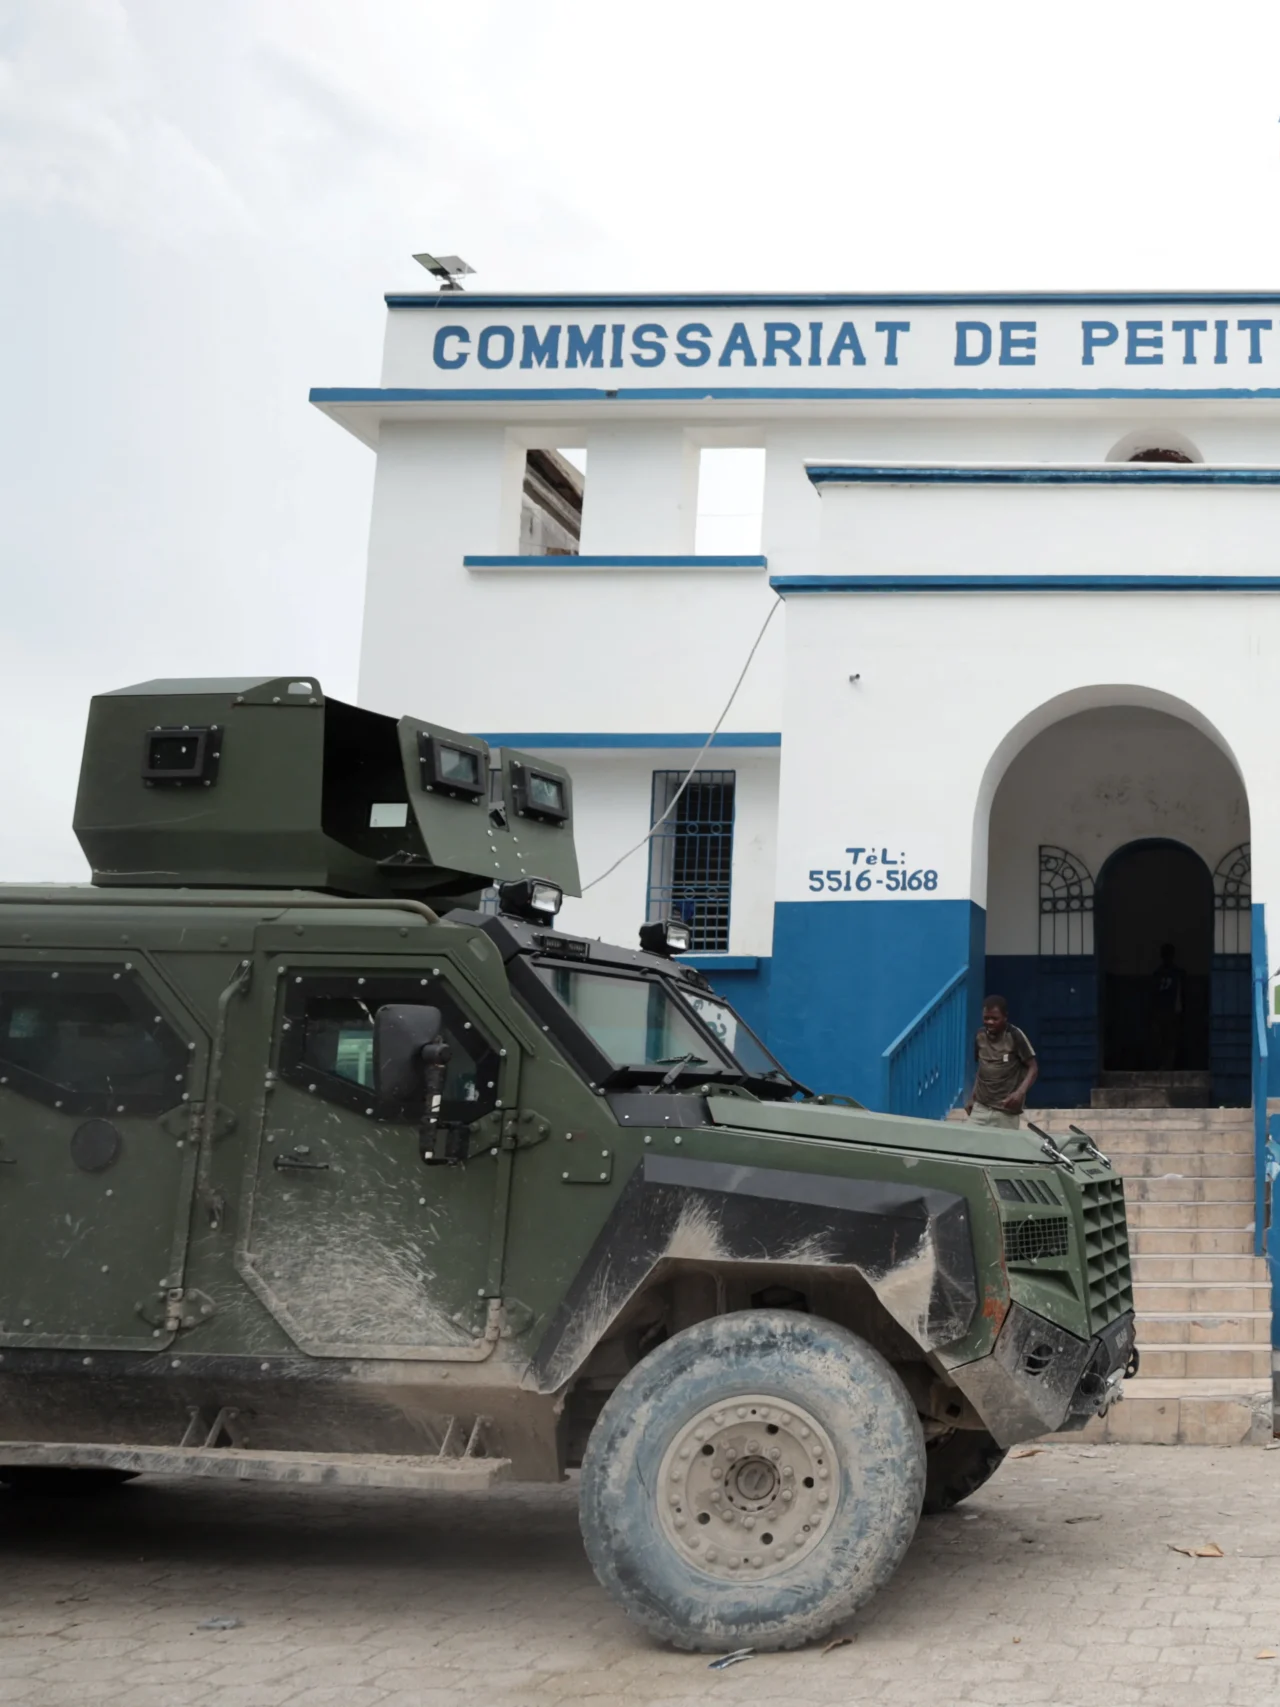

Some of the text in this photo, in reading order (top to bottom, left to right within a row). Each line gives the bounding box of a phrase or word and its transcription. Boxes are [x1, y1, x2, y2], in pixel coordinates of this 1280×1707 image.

[432, 321, 911, 370] COMMISSARIAT
[954, 320, 1037, 366] DE
[808, 869, 939, 893] 5516-5168
